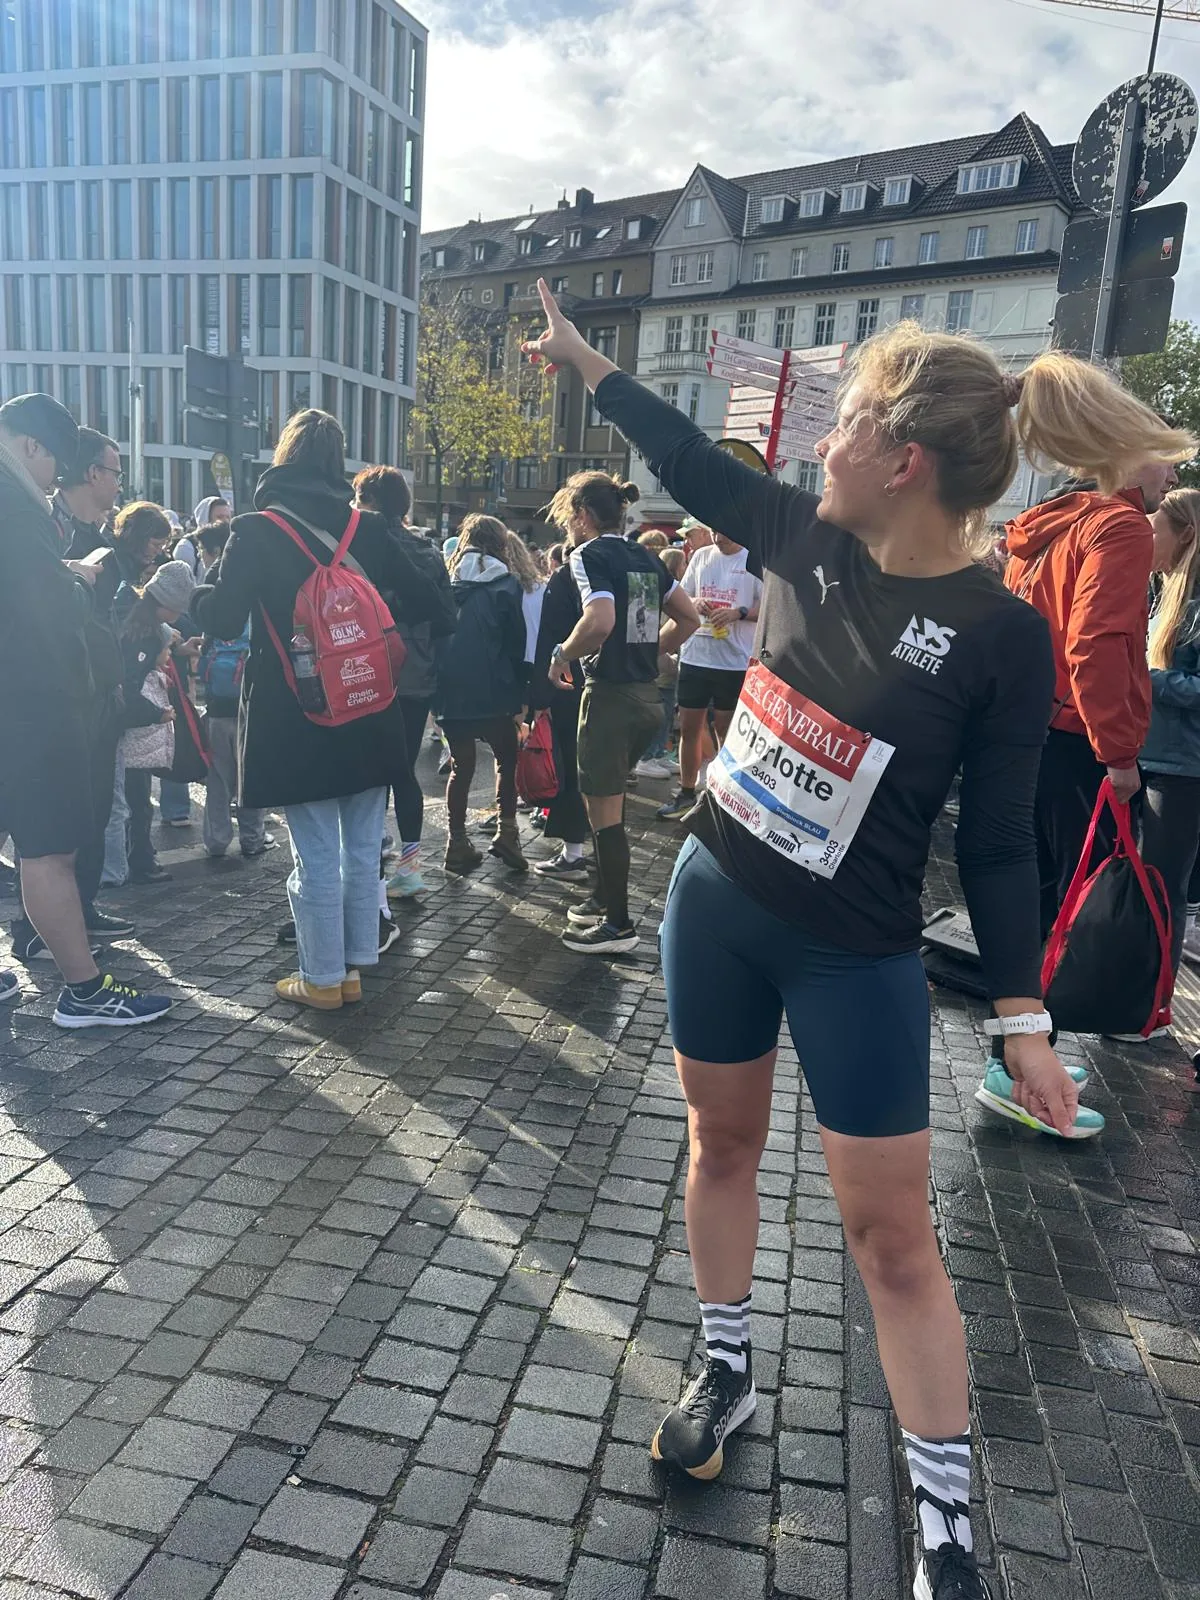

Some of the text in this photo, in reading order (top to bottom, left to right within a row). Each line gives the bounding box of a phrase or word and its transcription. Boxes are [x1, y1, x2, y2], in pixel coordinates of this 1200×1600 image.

[890, 642, 944, 675] ATHLETE
[342, 672, 376, 686] GENERALI
[347, 692, 379, 706] Energie
[349, 688, 374, 699] Rhein
[761, 688, 860, 768] GENERALI
[737, 711, 834, 802] Charlotte
[751, 765, 777, 790] 3403
[718, 786, 752, 822] MARATHON
[804, 822, 822, 836] BLAU
[766, 830, 797, 854] PUMA
[820, 840, 839, 866] 3403
[828, 844, 846, 870] Charlotte
